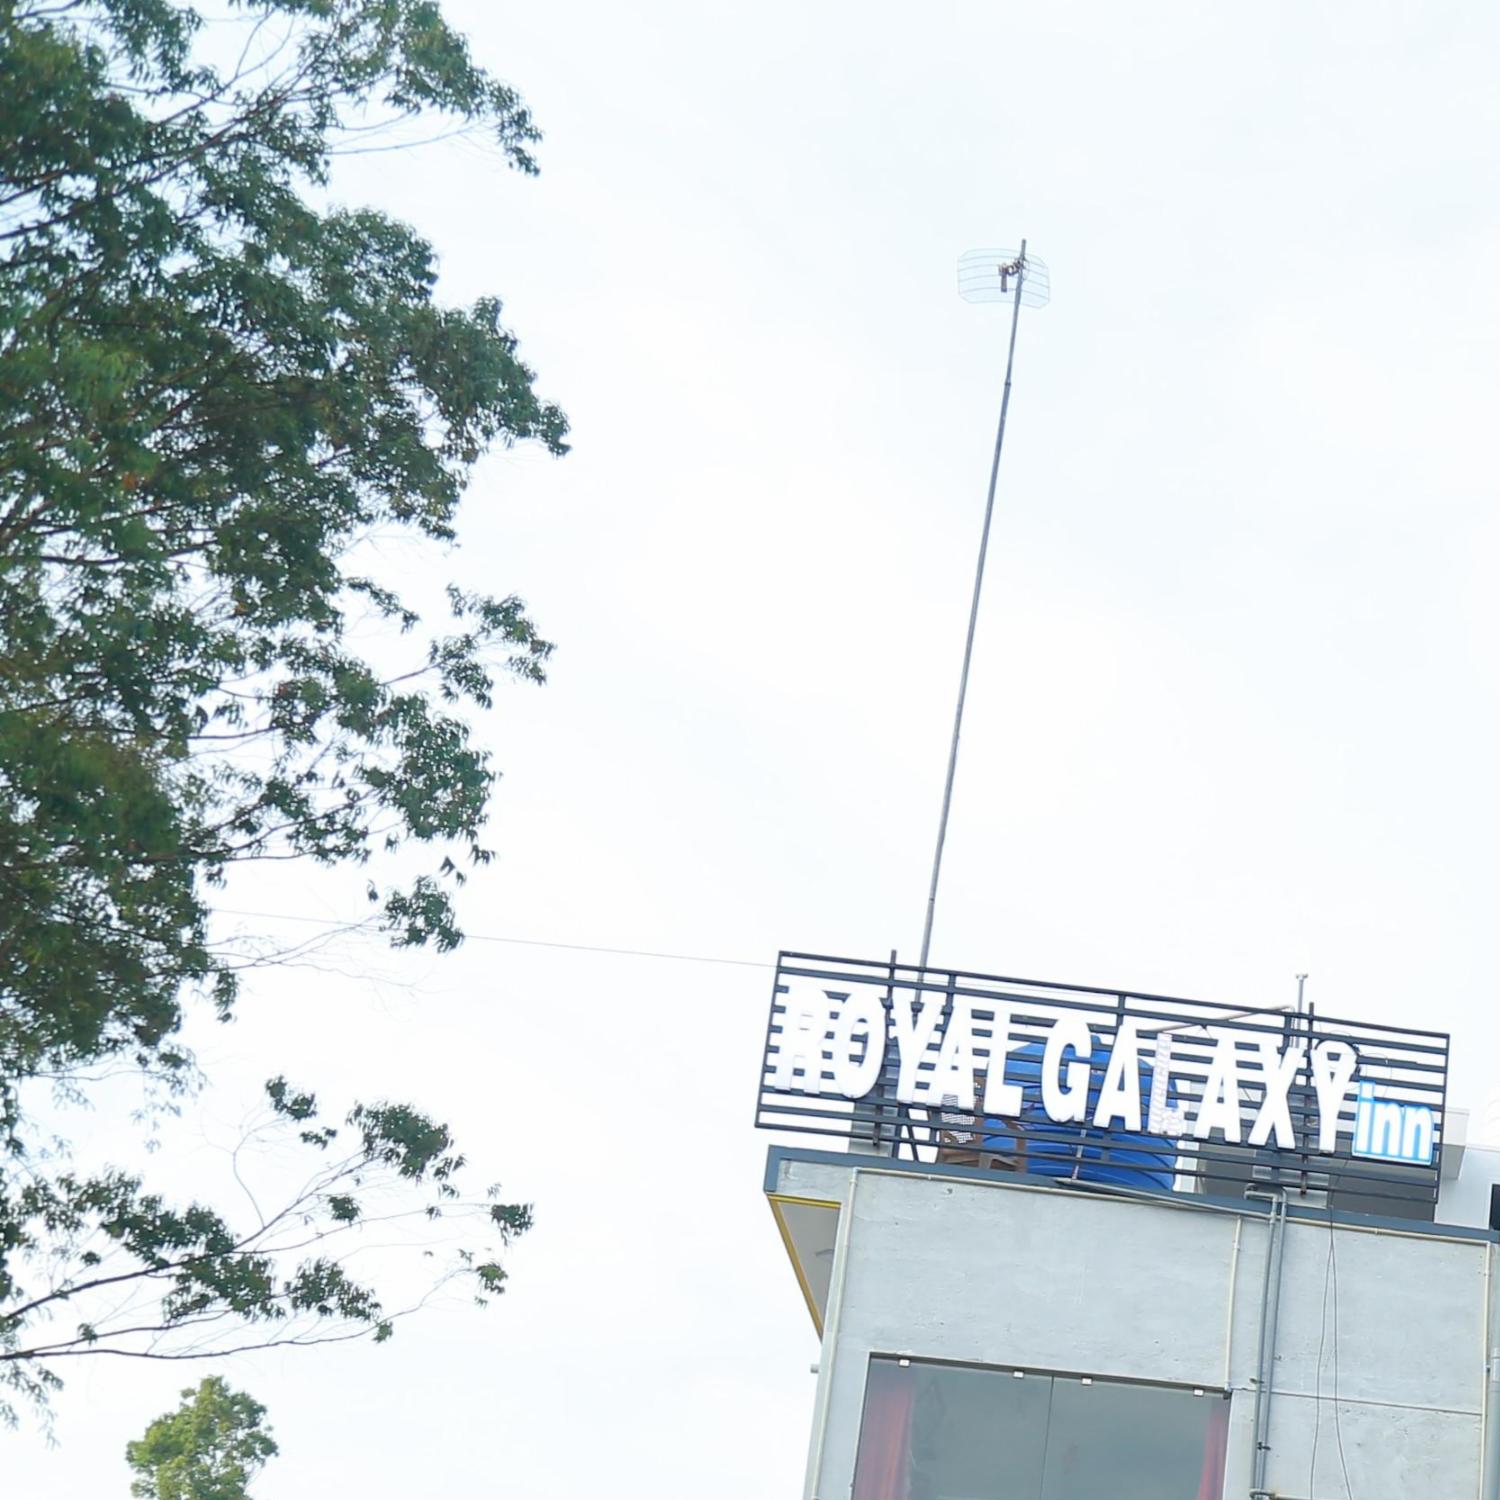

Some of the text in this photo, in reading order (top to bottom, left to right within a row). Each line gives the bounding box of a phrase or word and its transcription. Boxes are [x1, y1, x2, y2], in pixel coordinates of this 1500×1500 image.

[775, 981, 1433, 1165] ROYAL GALAXY inn
